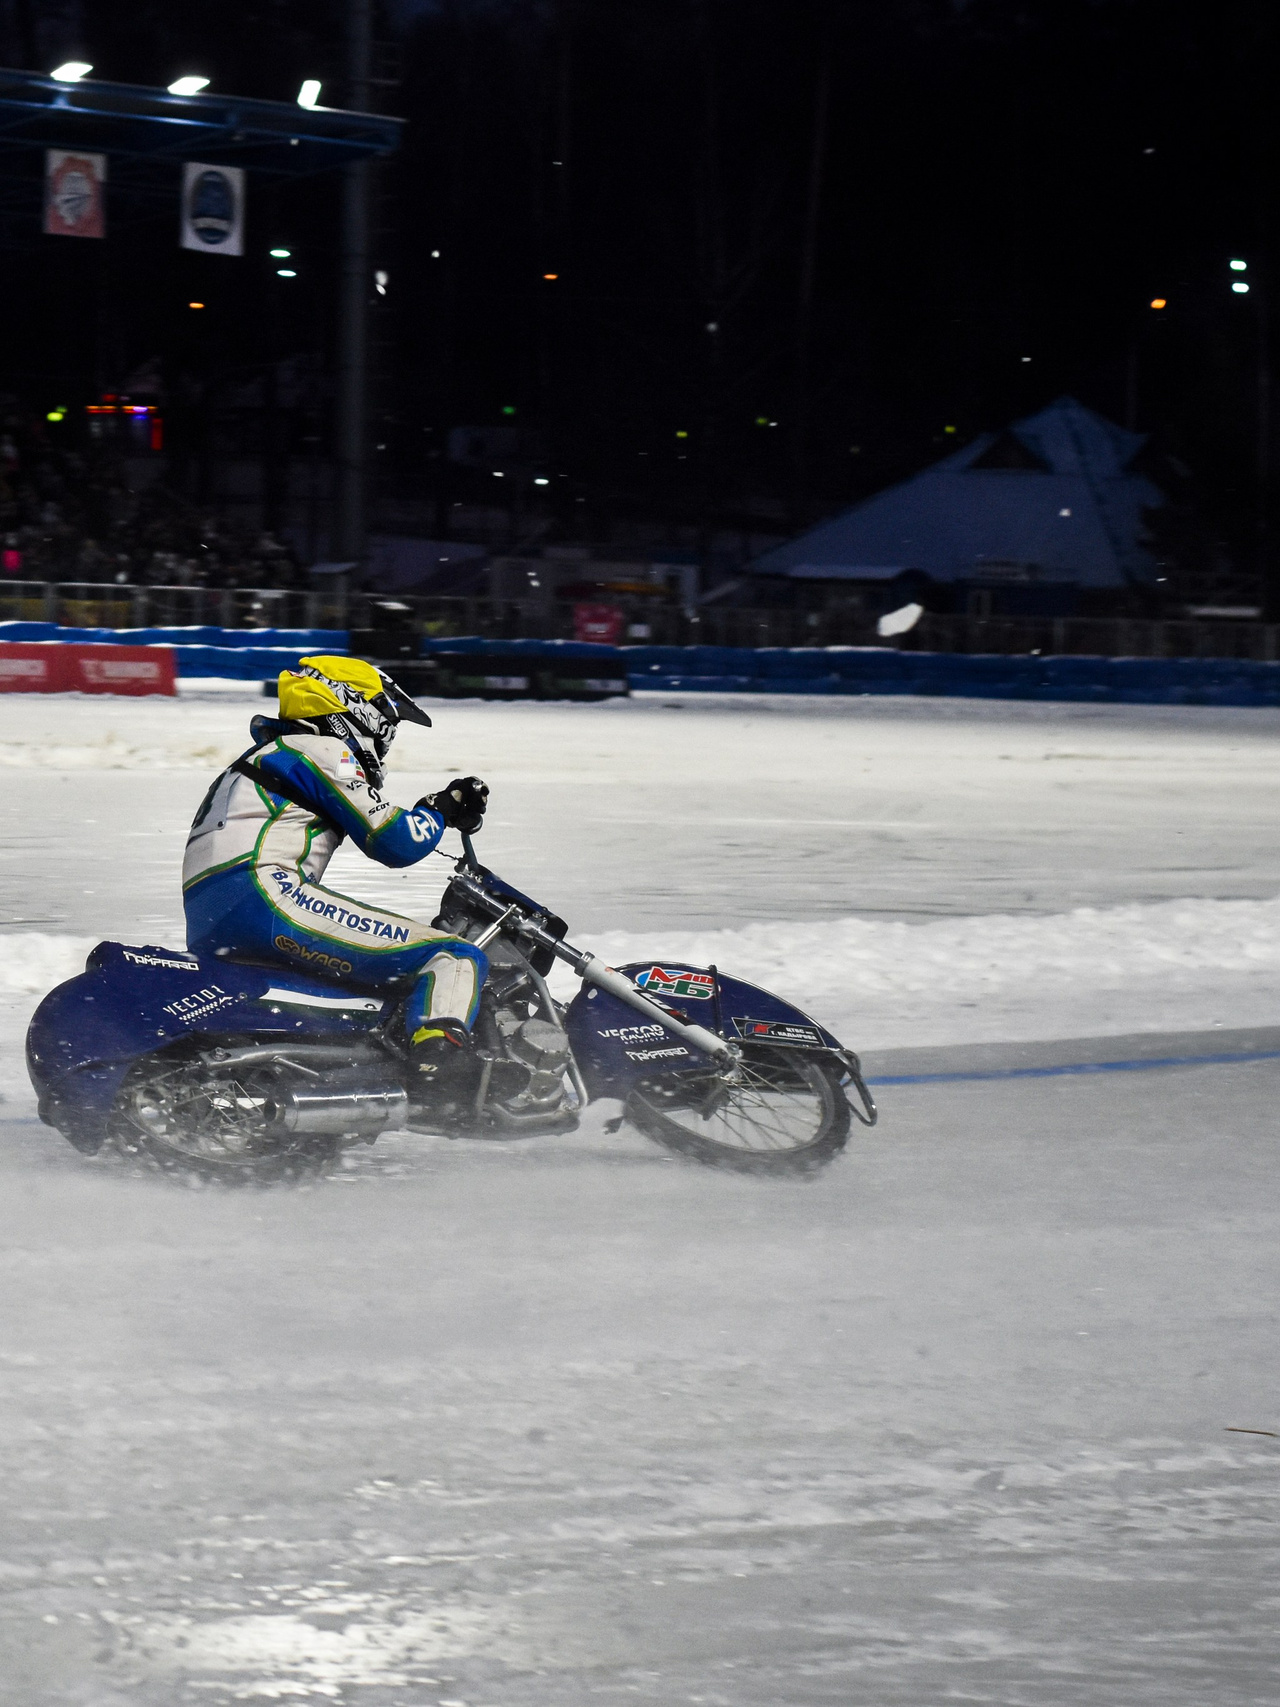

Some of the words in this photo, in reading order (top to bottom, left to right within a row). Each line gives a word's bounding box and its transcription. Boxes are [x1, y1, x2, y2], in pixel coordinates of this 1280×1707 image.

[328, 713, 348, 737] SHOEI
[272, 871, 409, 942] BAHKORTOSTAN
[301, 946, 352, 973] WACO
[162, 985, 225, 1016] VECTOR
[597, 1024, 664, 1038] VECTOR
[620, 1029, 665, 1041] RACING
